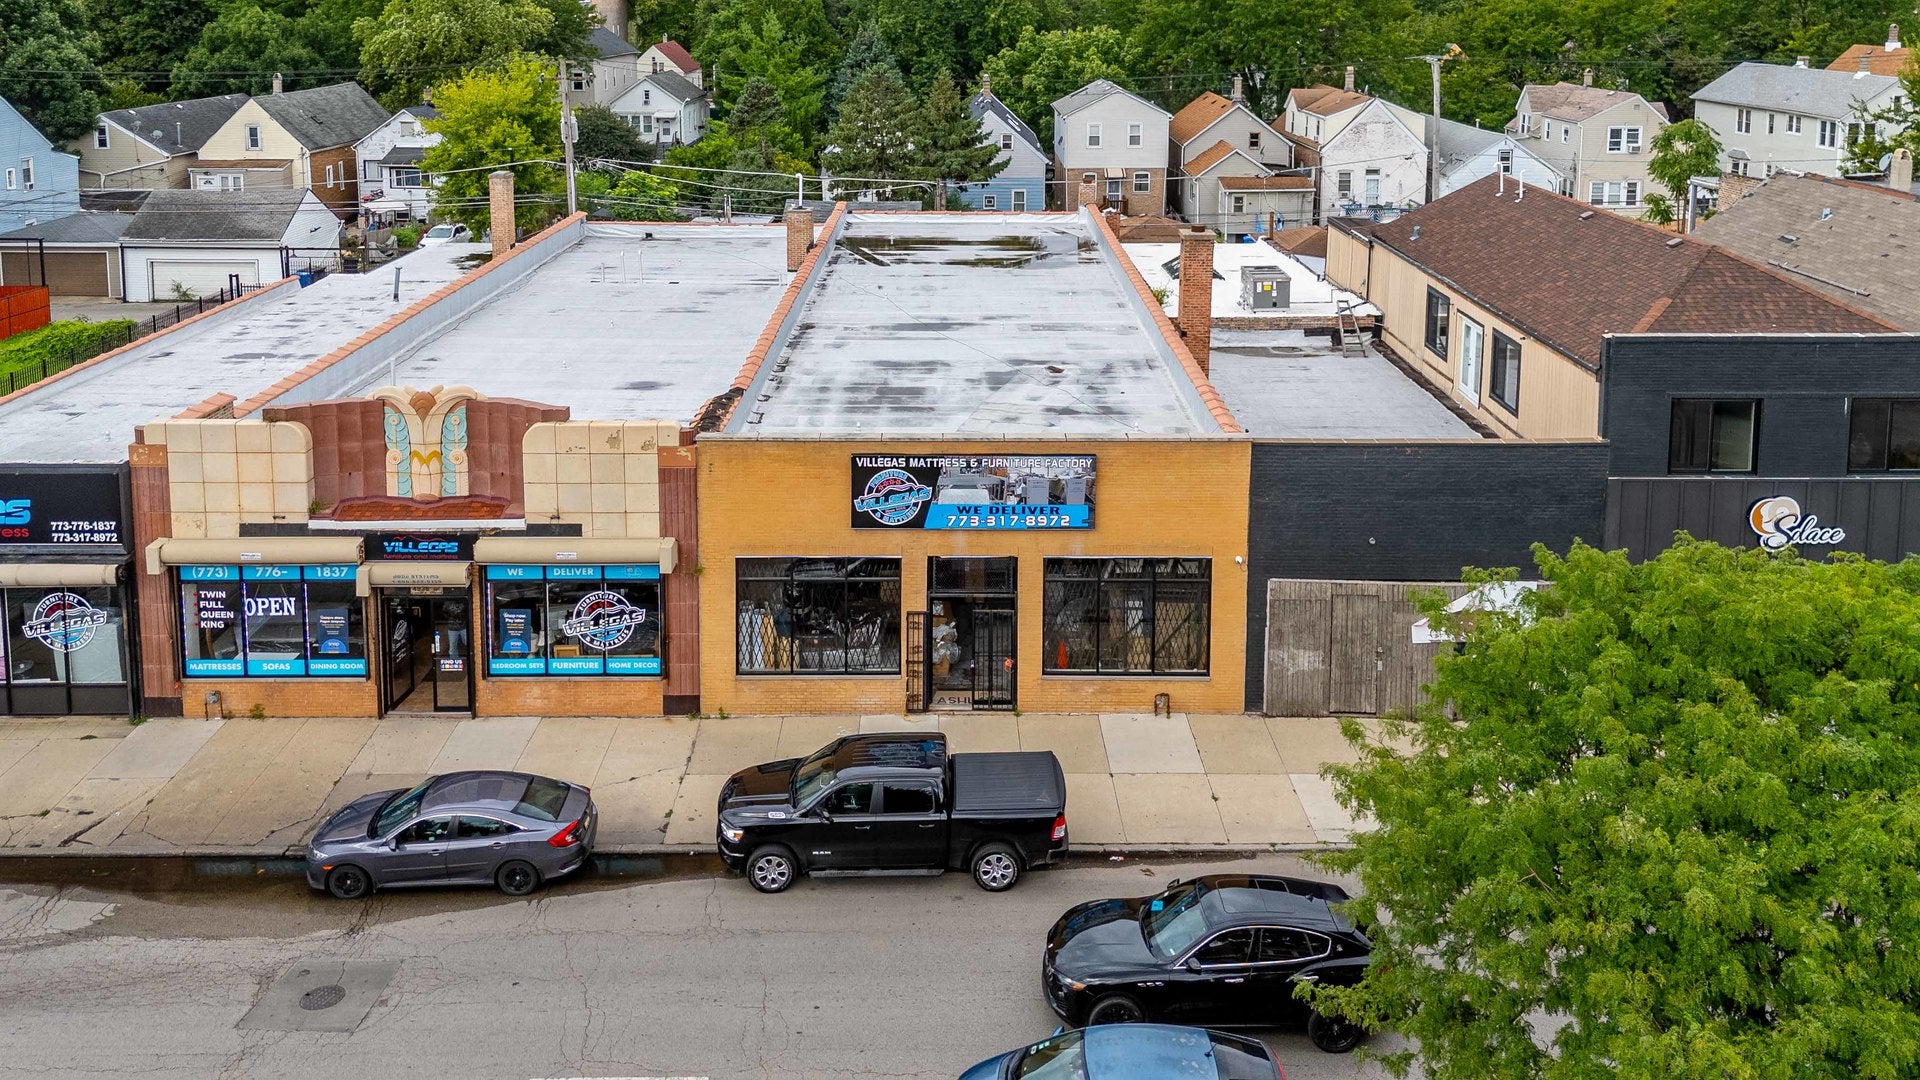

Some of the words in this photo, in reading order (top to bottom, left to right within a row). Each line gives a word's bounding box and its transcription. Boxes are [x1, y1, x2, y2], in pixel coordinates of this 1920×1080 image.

[856, 457, 906, 467] VILLEGAS
[909, 458, 967, 467] MATTRESS
[970, 458, 978, 467] &
[981, 458, 1041, 467] FURNITURE
[1044, 458, 1093, 467] FACTORY
[956, 506, 982, 514] WE
[989, 506, 1060, 514] DELIVER
[50, 521, 116, 531] 773-776-1837
[947, 515, 1070, 527] 773-317-8972
[52, 533, 118, 542] 773-317-8972
[383, 541, 458, 553] VILLEGAS
[192, 566, 228, 578] (773)
[255, 566, 288, 577] 776-
[316, 566, 348, 577] 1837
[507, 568, 524, 576] WE
[553, 568, 594, 576] DELIVER
[244, 597, 296, 616] OPEN
[578, 594, 619, 611] FURNITURE
[200, 611, 234, 619] QUEEN
[25, 615, 104, 636] VILLEGAS
[200, 621, 225, 629] KING
[565, 612, 643, 634] VILLEGAS
[593, 629, 630, 648] MATTRESS
